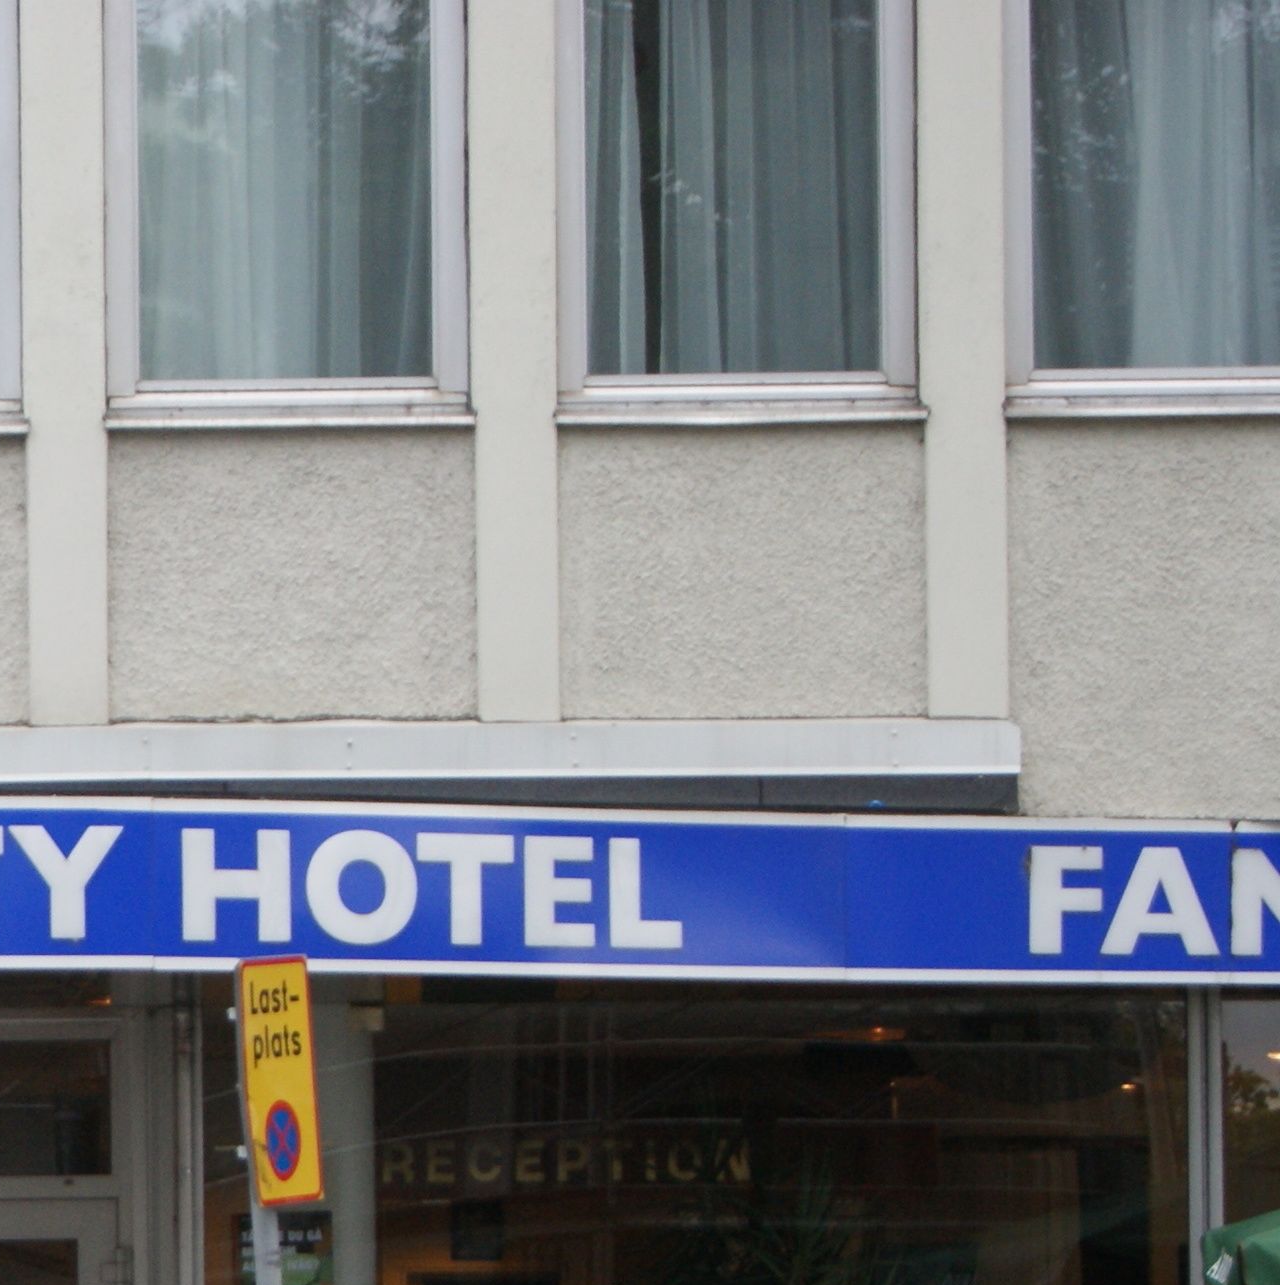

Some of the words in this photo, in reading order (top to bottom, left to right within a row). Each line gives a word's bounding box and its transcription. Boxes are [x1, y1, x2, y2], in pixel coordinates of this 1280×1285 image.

[181, 827, 684, 951] HOTEL
[250, 980, 300, 1015] Last-
[253, 1025, 302, 1068] plats
[382, 1138, 751, 1184] RECEPTION
